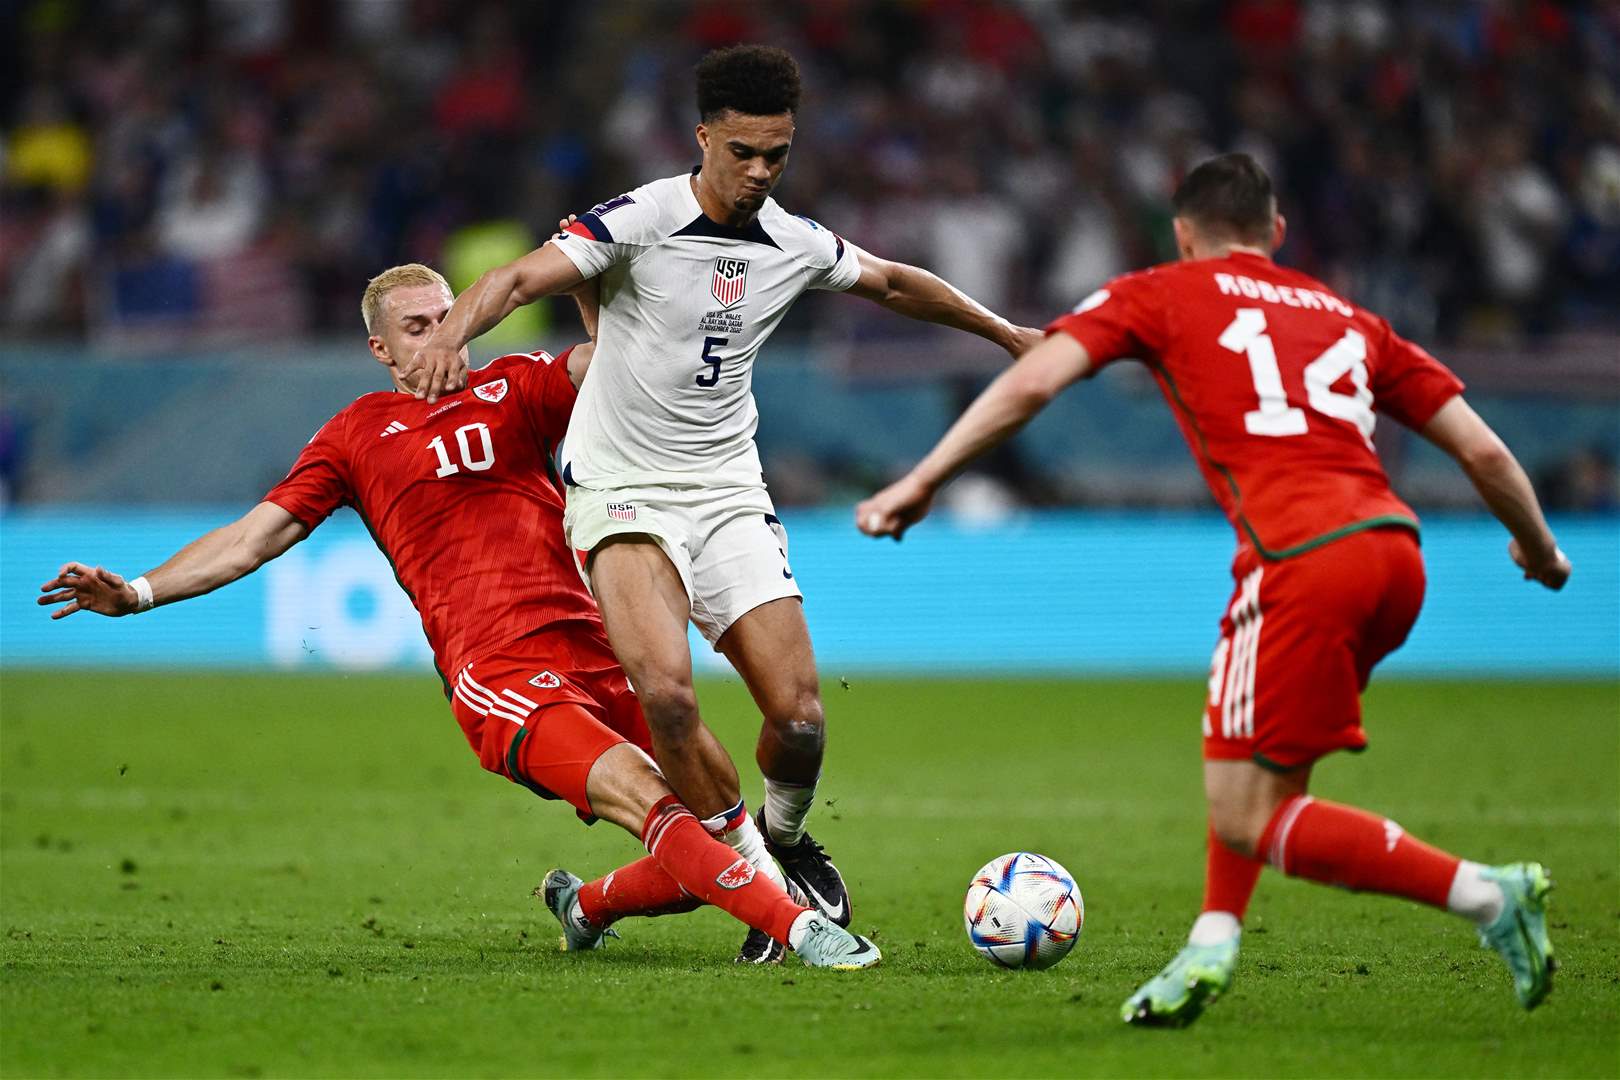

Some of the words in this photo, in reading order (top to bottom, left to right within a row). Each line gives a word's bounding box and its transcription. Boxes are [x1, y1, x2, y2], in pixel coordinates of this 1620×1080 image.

[717, 259, 746, 279] USA
[696, 336, 729, 387] 5
[1217, 307, 1377, 453] 14
[426, 422, 496, 479] 10
